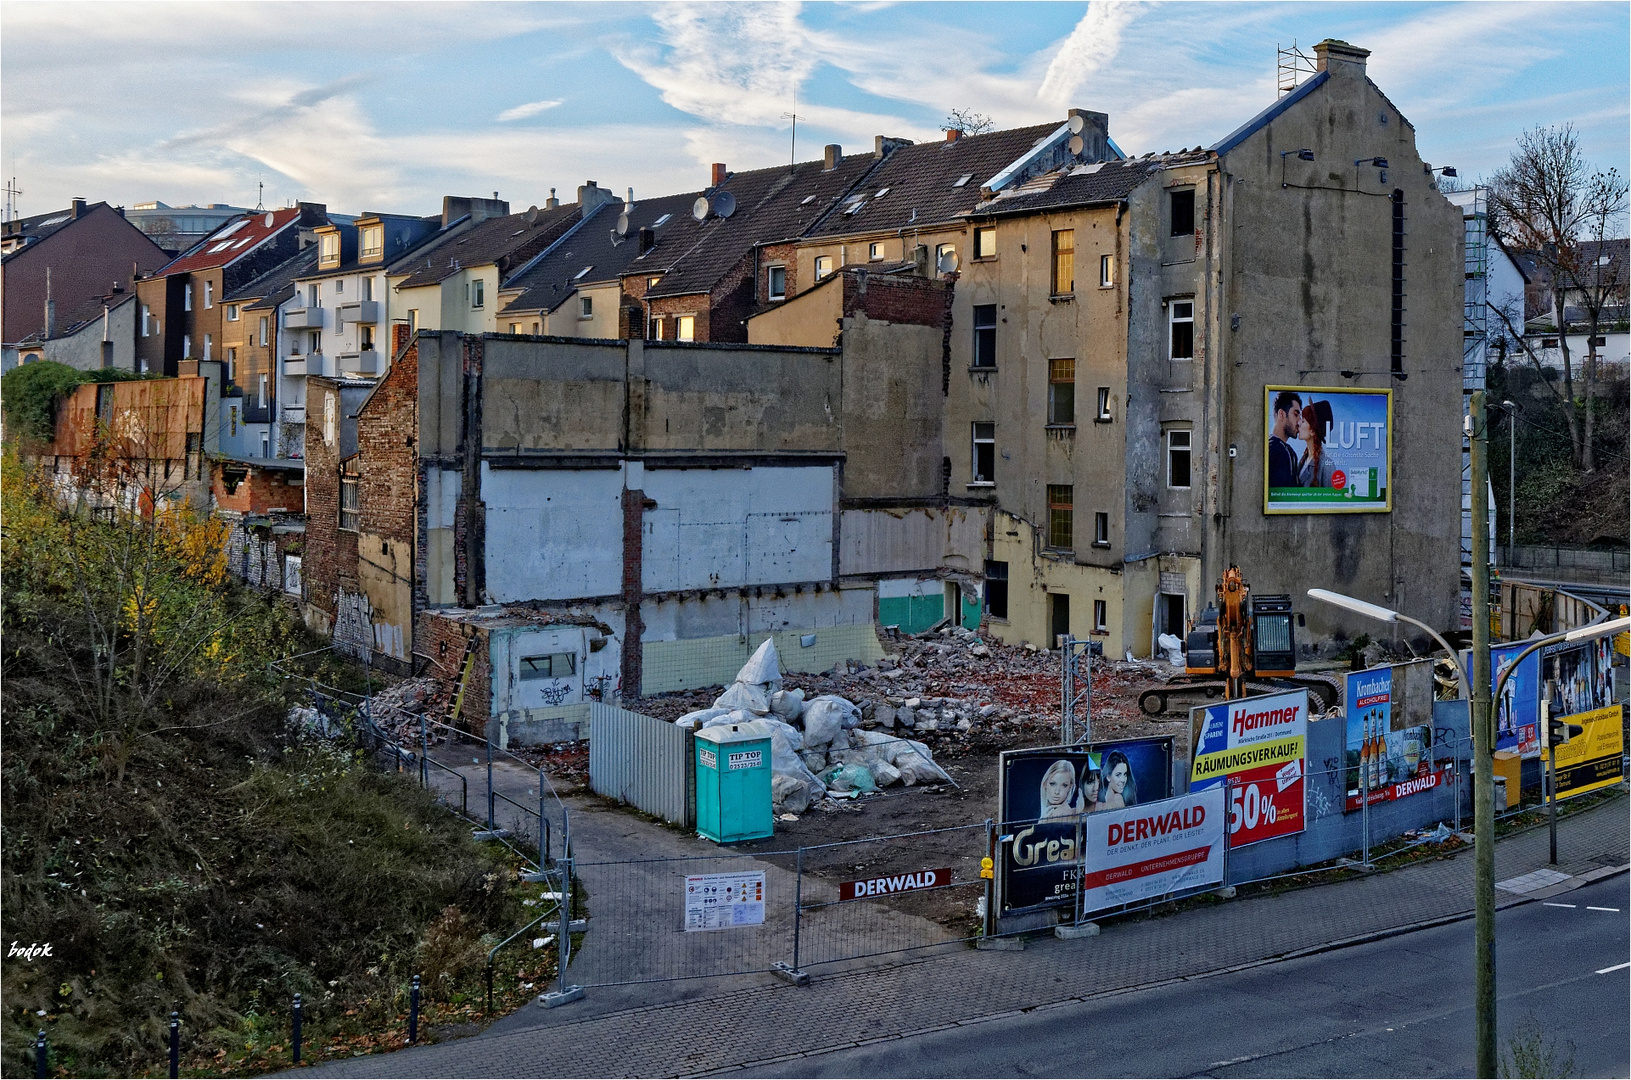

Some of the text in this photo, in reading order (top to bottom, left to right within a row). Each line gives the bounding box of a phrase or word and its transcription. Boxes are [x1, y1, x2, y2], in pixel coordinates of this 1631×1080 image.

[1326, 421, 1385, 450] LUFT
[1356, 676, 1391, 698] Krombacher
[1232, 705, 1300, 737] Hammer
[744, 751, 761, 759] TOP
[1196, 742, 1298, 775] RÄUMUNGSVERKAUF!
[1395, 774, 1436, 798] DERWALD
[1107, 805, 1206, 847] DERWALD
[1105, 851, 1206, 880] DERWALD UNTERNEHMENSGRUPPE
[1107, 848, 1118, 856] DER
[854, 871, 937, 897] DERWALD
